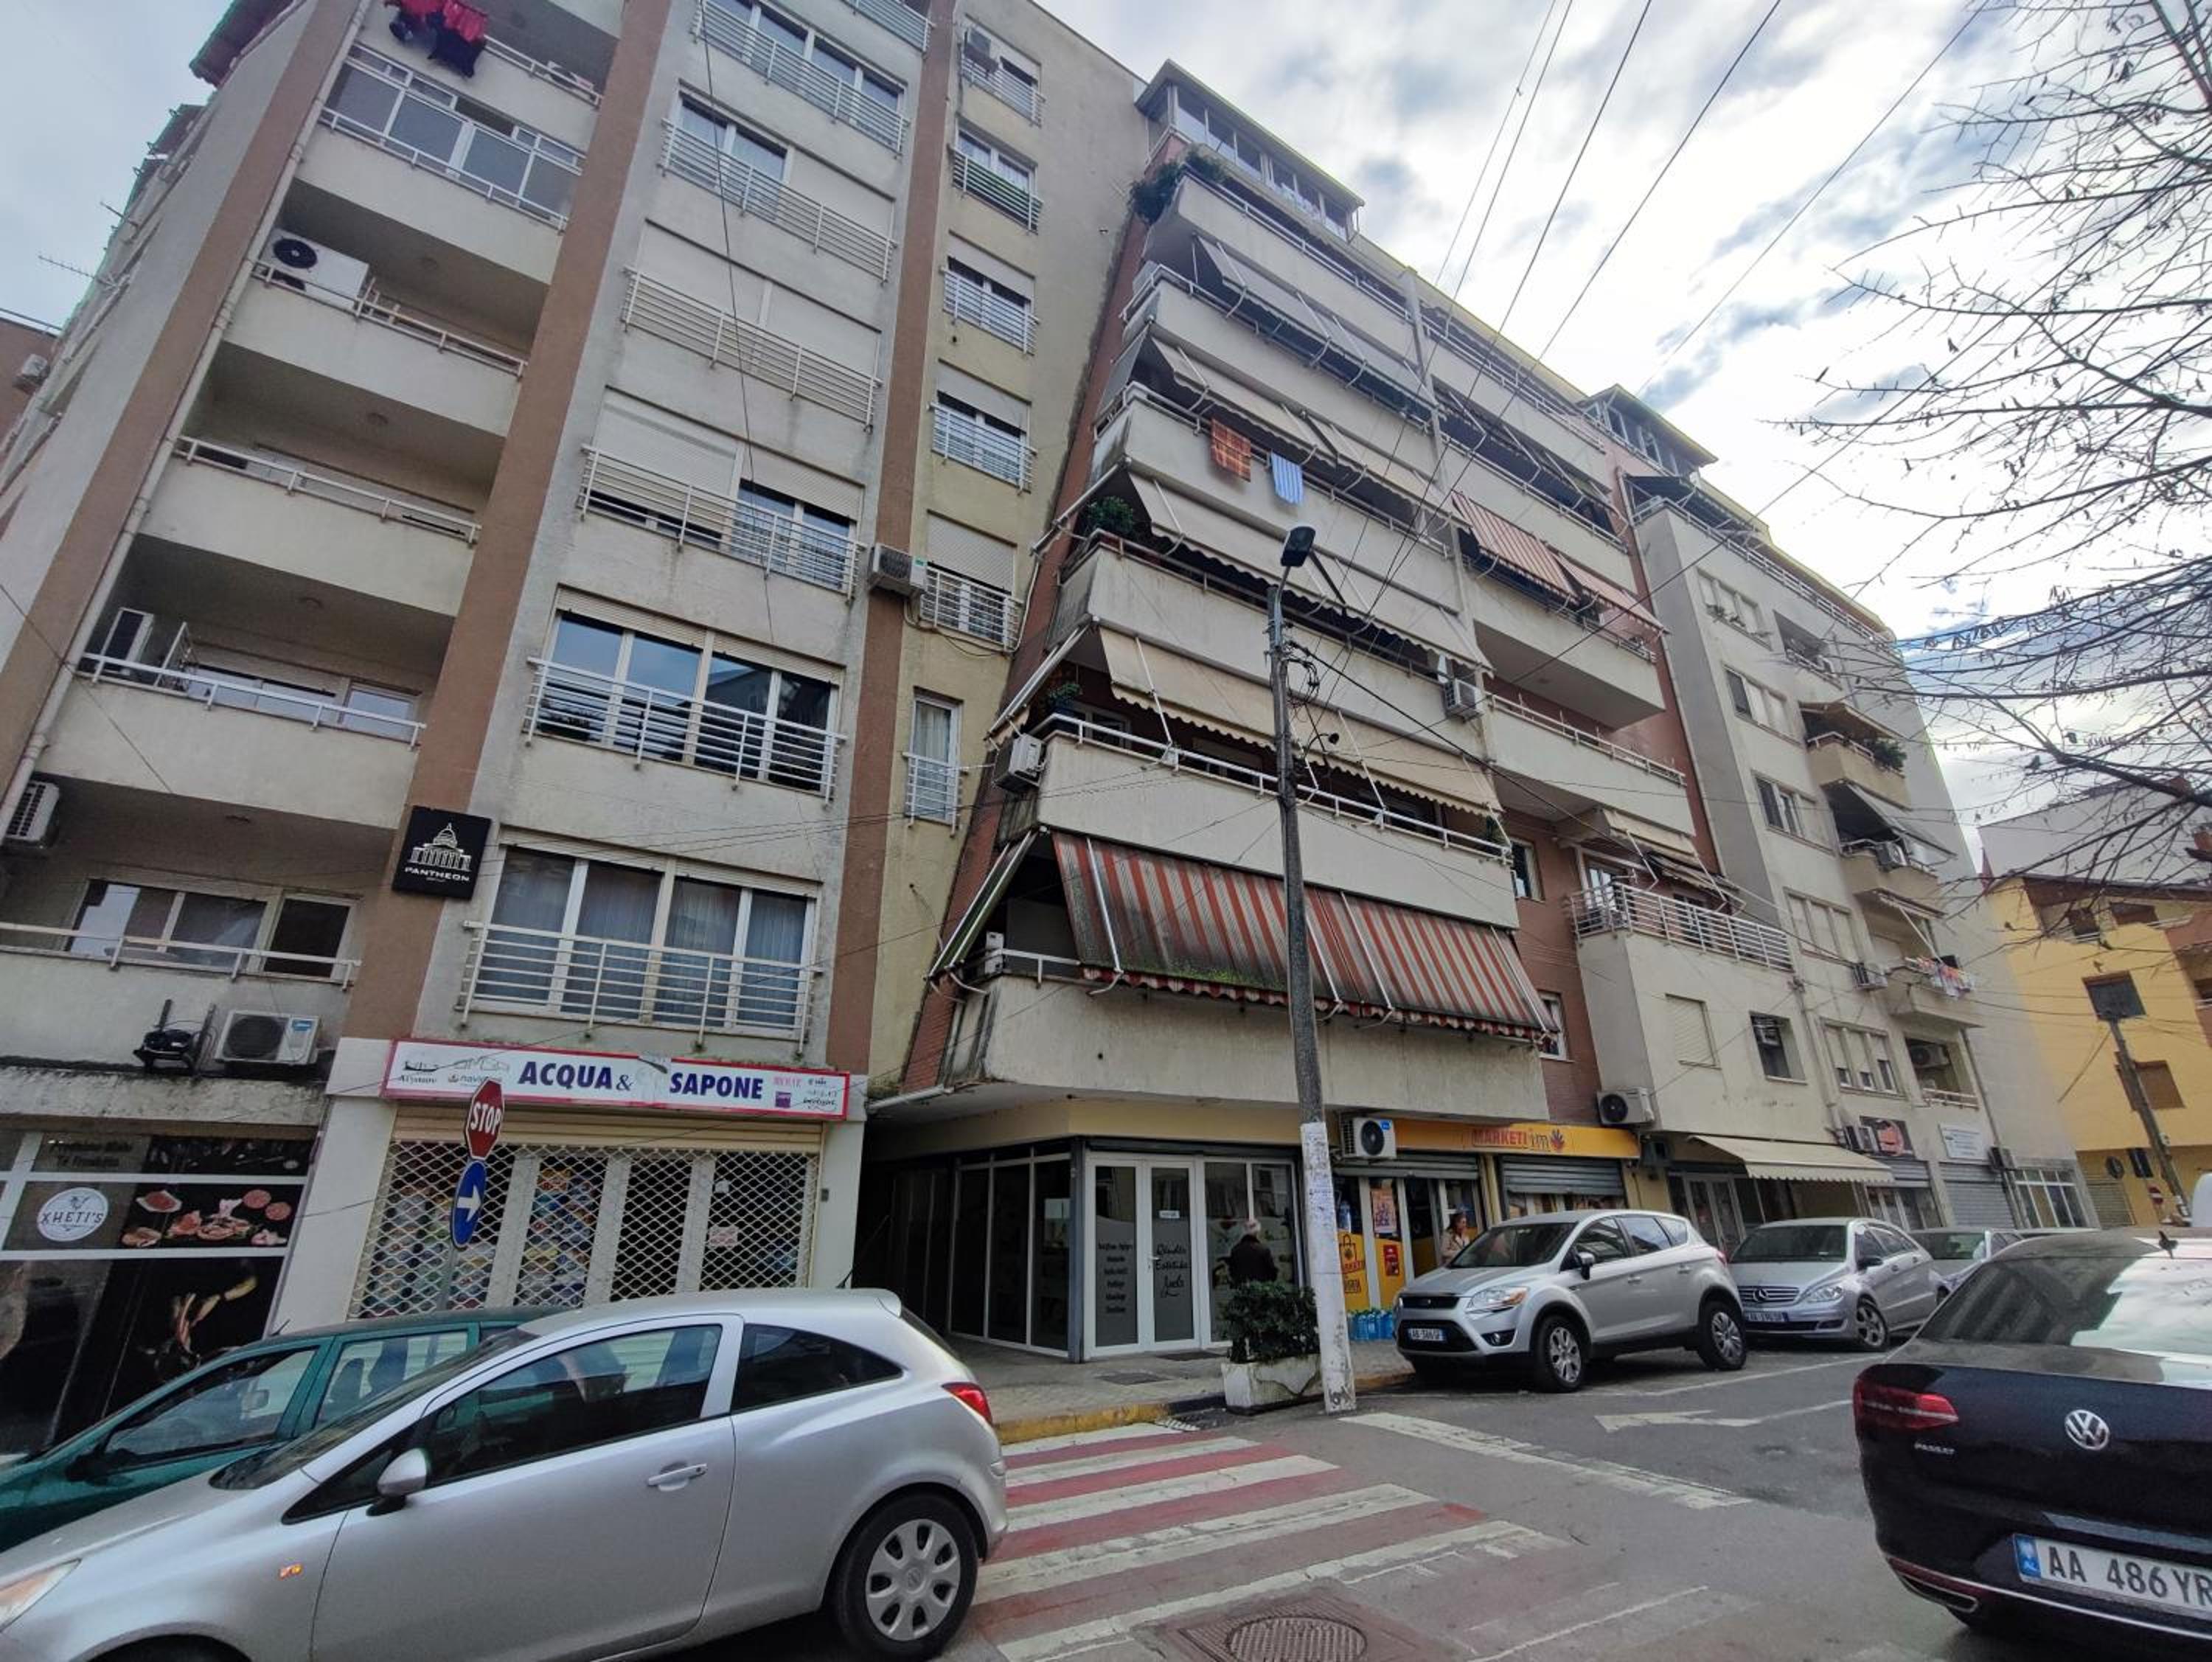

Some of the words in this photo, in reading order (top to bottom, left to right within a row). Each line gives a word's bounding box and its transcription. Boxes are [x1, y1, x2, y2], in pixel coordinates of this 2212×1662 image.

[405, 867, 470, 881] PANTHEON
[518, 1061, 612, 1090] ACQUA
[616, 1074, 633, 1091] &
[669, 1072, 763, 1099] SAPONE
[470, 1102, 501, 1136] STOP
[41, 1211, 104, 1225] XHETI'S
[1915, 1440, 1954, 1455] PASSAT
[2048, 1545, 2087, 1583] AA
[2107, 1558, 2168, 1598] 486
[2171, 1568, 2212, 1607] YR
